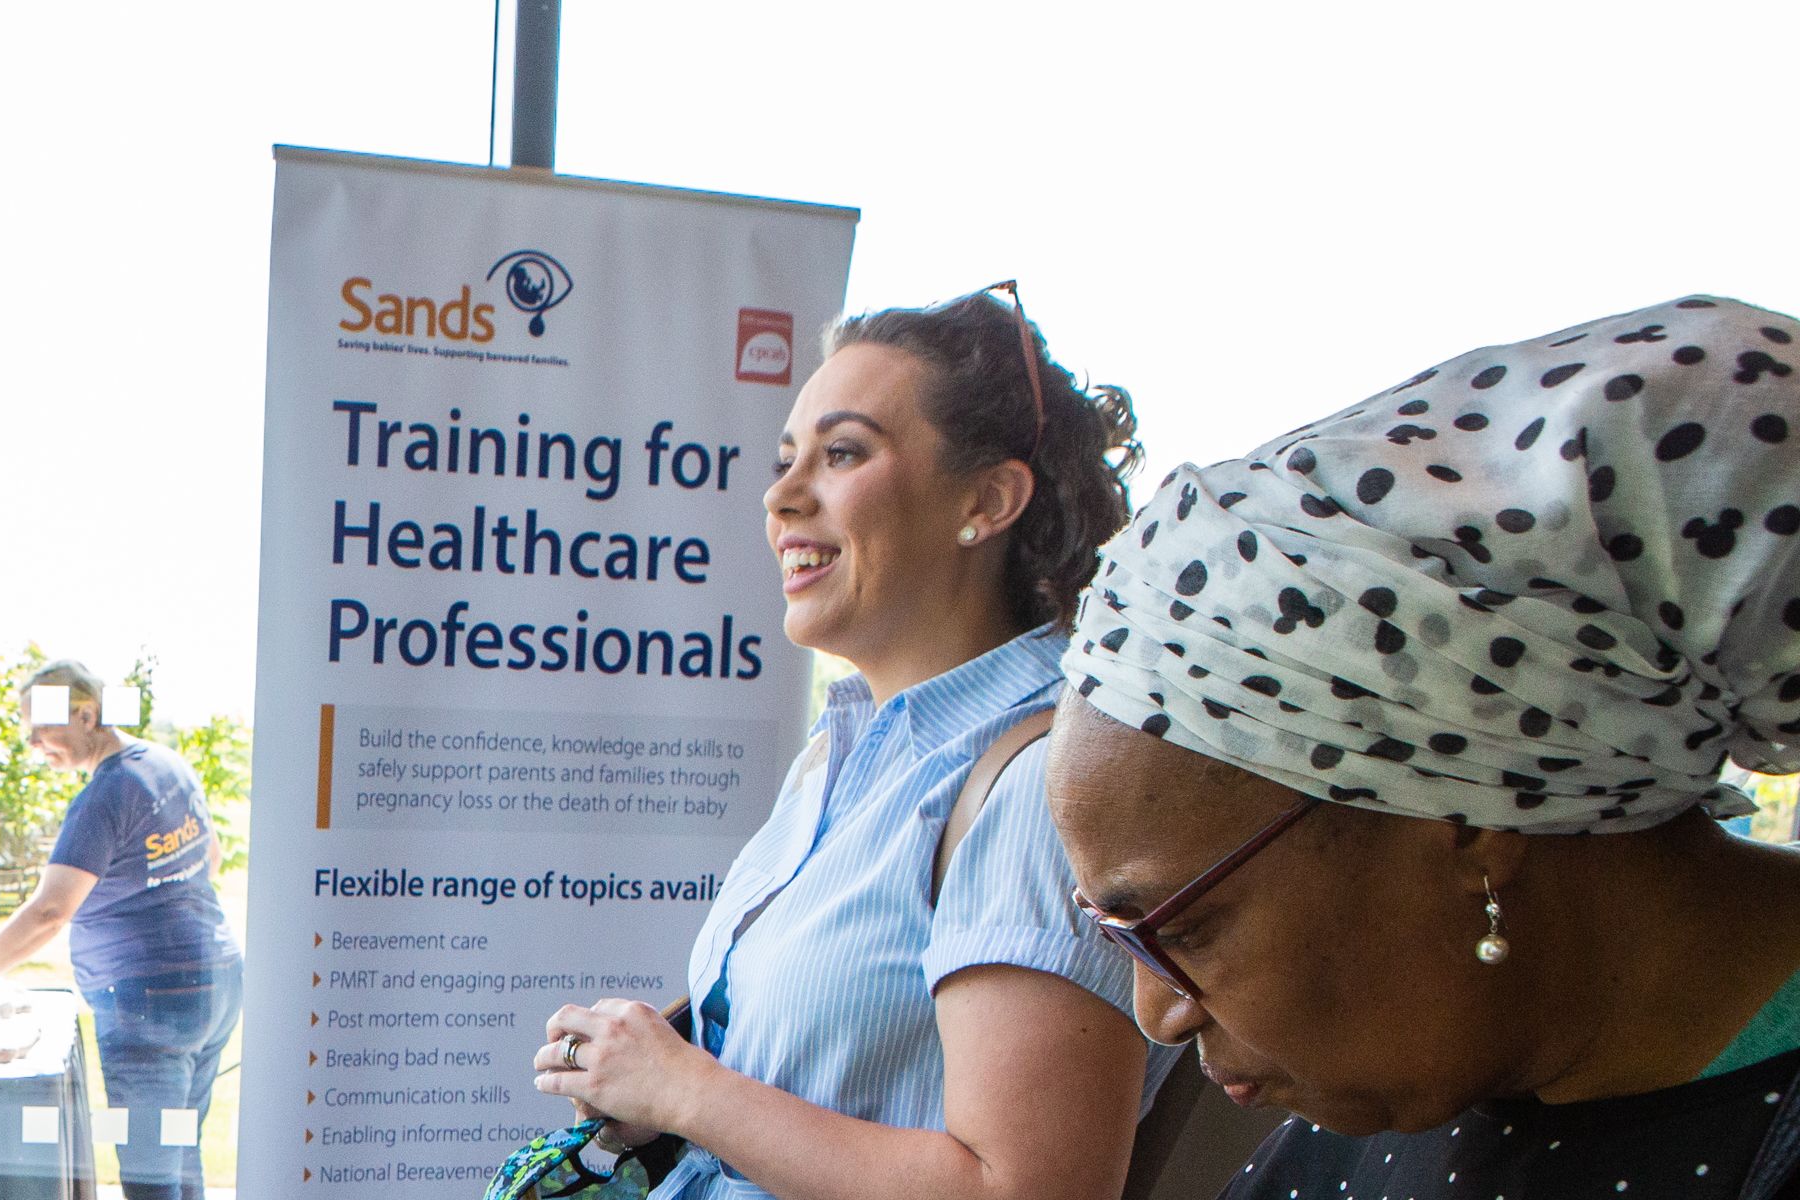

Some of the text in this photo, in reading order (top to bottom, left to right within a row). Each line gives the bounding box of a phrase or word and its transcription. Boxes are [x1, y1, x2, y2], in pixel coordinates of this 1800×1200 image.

[339, 277, 496, 343] Sands
[332, 400, 740, 501] Training for
[332, 500, 711, 584] Healthcare
[328, 599, 763, 681] Professionals
[359, 728, 744, 761] Build the confidence, knowledge and skills to
[358, 757, 741, 792] safely support parents and families through
[356, 790, 728, 820] pregnancy loss or the death of their baby
[145, 815, 200, 860] Sands
[315, 868, 643, 906] Flexible range of topics
[331, 930, 489, 951] Bereavement care
[329, 971, 664, 994] PMRT and engaging parents in reviews
[327, 1010, 517, 1029] Post mortem consent
[325, 1048, 491, 1071] Breaking bad news
[323, 1086, 511, 1108] Communication skills
[322, 1124, 546, 1148] Enabling informed choice
[319, 1164, 391, 1183] National
